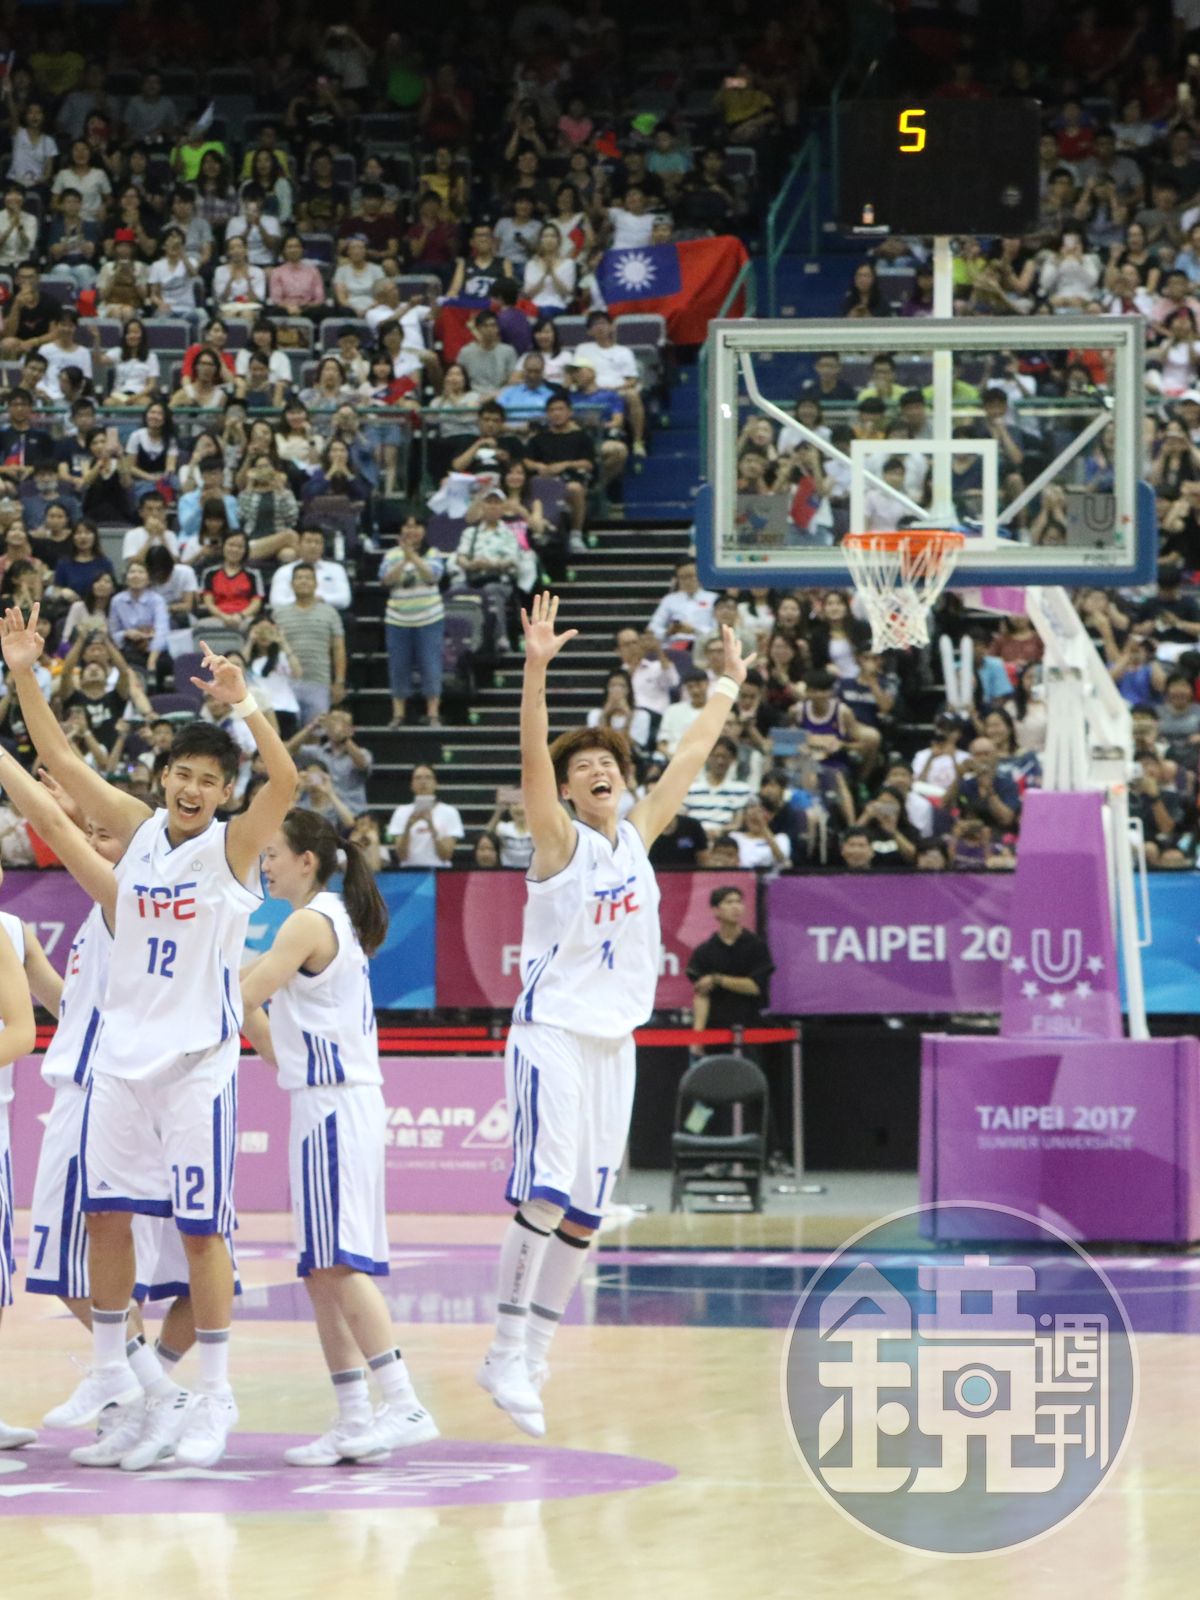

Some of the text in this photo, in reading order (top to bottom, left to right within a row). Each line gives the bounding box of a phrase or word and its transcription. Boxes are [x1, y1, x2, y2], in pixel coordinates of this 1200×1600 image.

[899, 109, 927, 152] 5
[133, 882, 198, 921] TPE
[146, 937, 178, 979] 12
[807, 925, 947, 962] TAIPEI
[975, 1105, 1137, 1131] TAIPEI 2017
[171, 1164, 205, 1210] 12
[33, 1225, 50, 1270] 7
